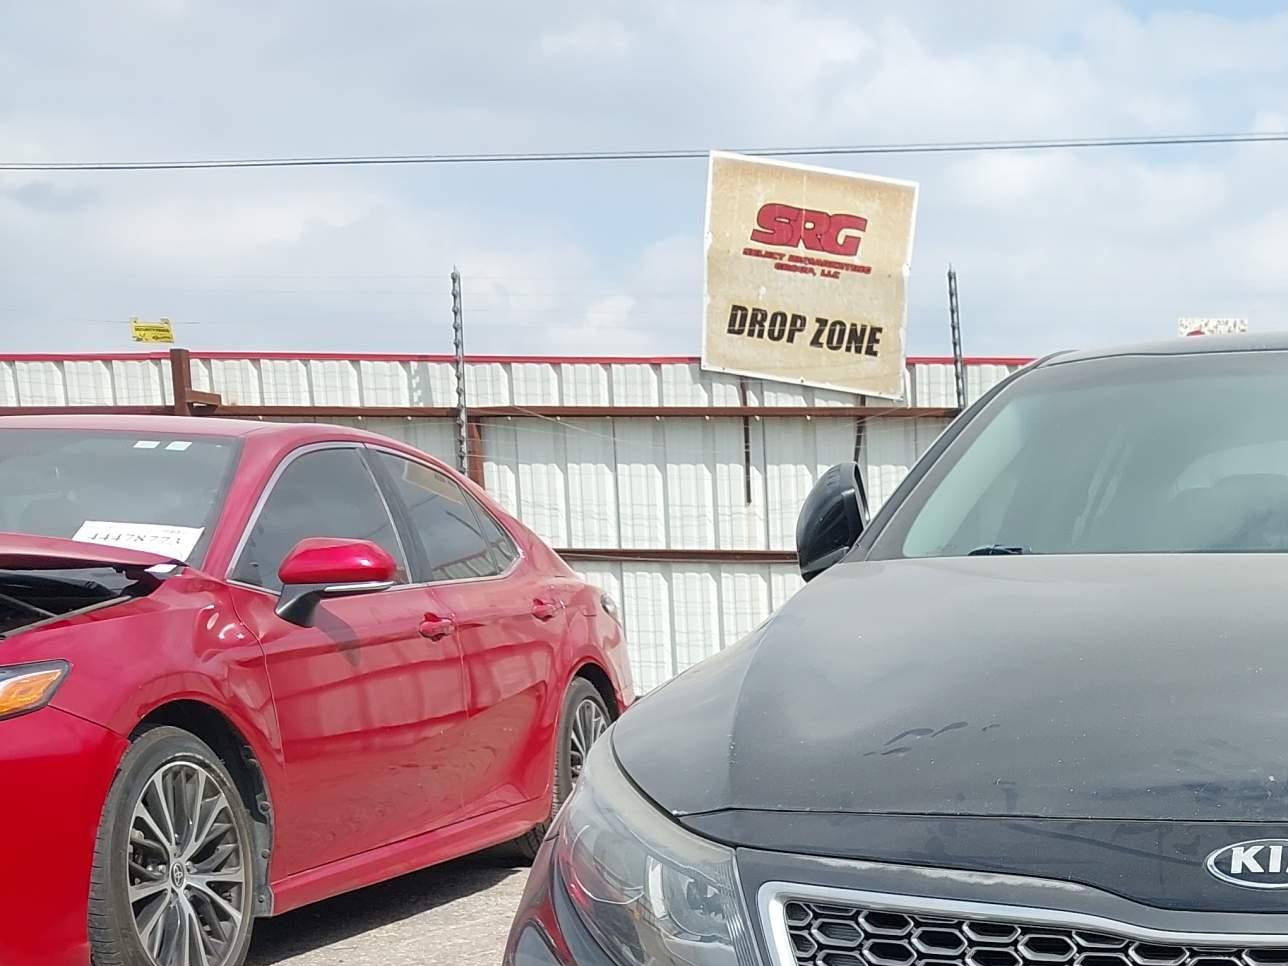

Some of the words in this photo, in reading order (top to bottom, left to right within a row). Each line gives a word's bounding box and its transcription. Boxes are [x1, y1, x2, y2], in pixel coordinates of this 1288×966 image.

[750, 203, 868, 256] SRG
[727, 304, 807, 344] DROP
[809, 317, 883, 357] ZONE
